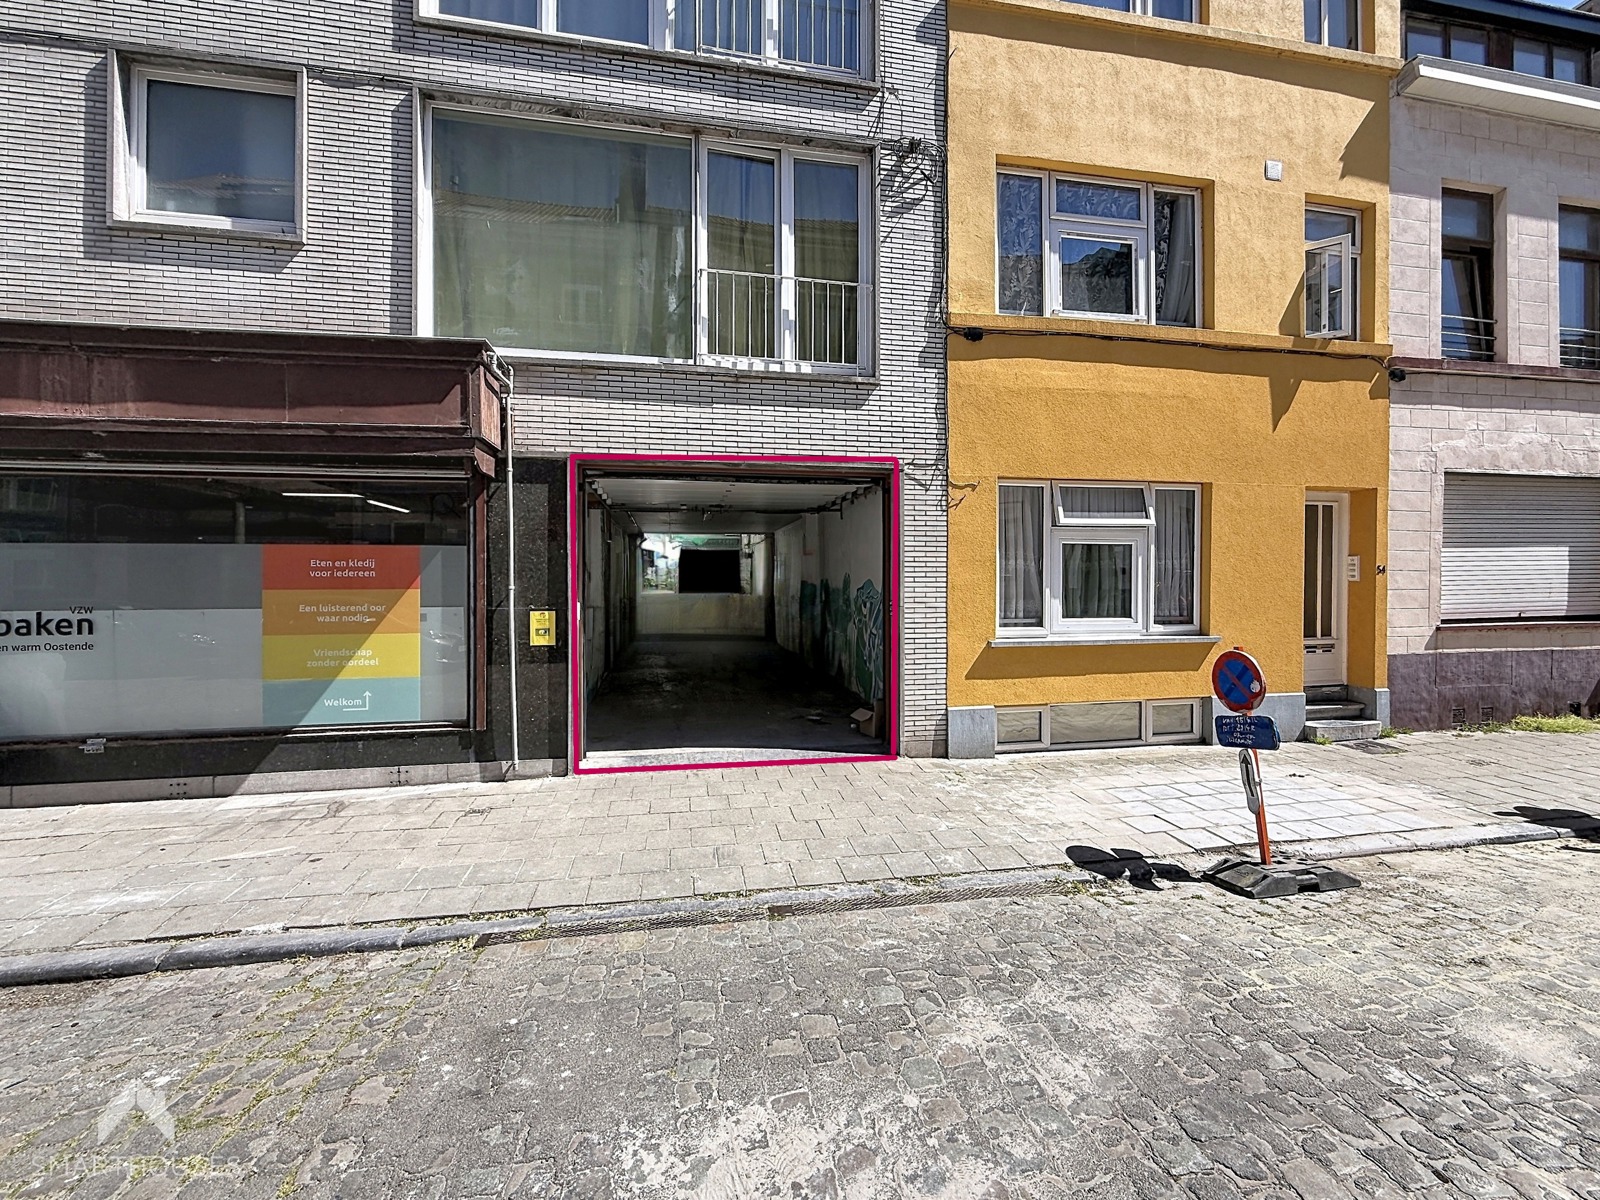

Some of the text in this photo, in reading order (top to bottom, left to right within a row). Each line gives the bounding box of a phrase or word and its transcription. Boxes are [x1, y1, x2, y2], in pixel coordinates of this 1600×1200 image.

[310, 559, 332, 567] Eten
[348, 559, 375, 568] kledij
[334, 569, 376, 577] iedereen
[1376, 565, 1386, 575] 54
[299, 604, 317, 612] Een
[319, 603, 367, 612] luisterend
[342, 613, 369, 623] nodig
[11, 644, 41, 652] warm
[44, 642, 94, 651] Oostende
[313, 648, 373, 657] Vriendschap
[306, 658, 379, 667] zonder oordeel
[323, 698, 362, 706] Welkom
